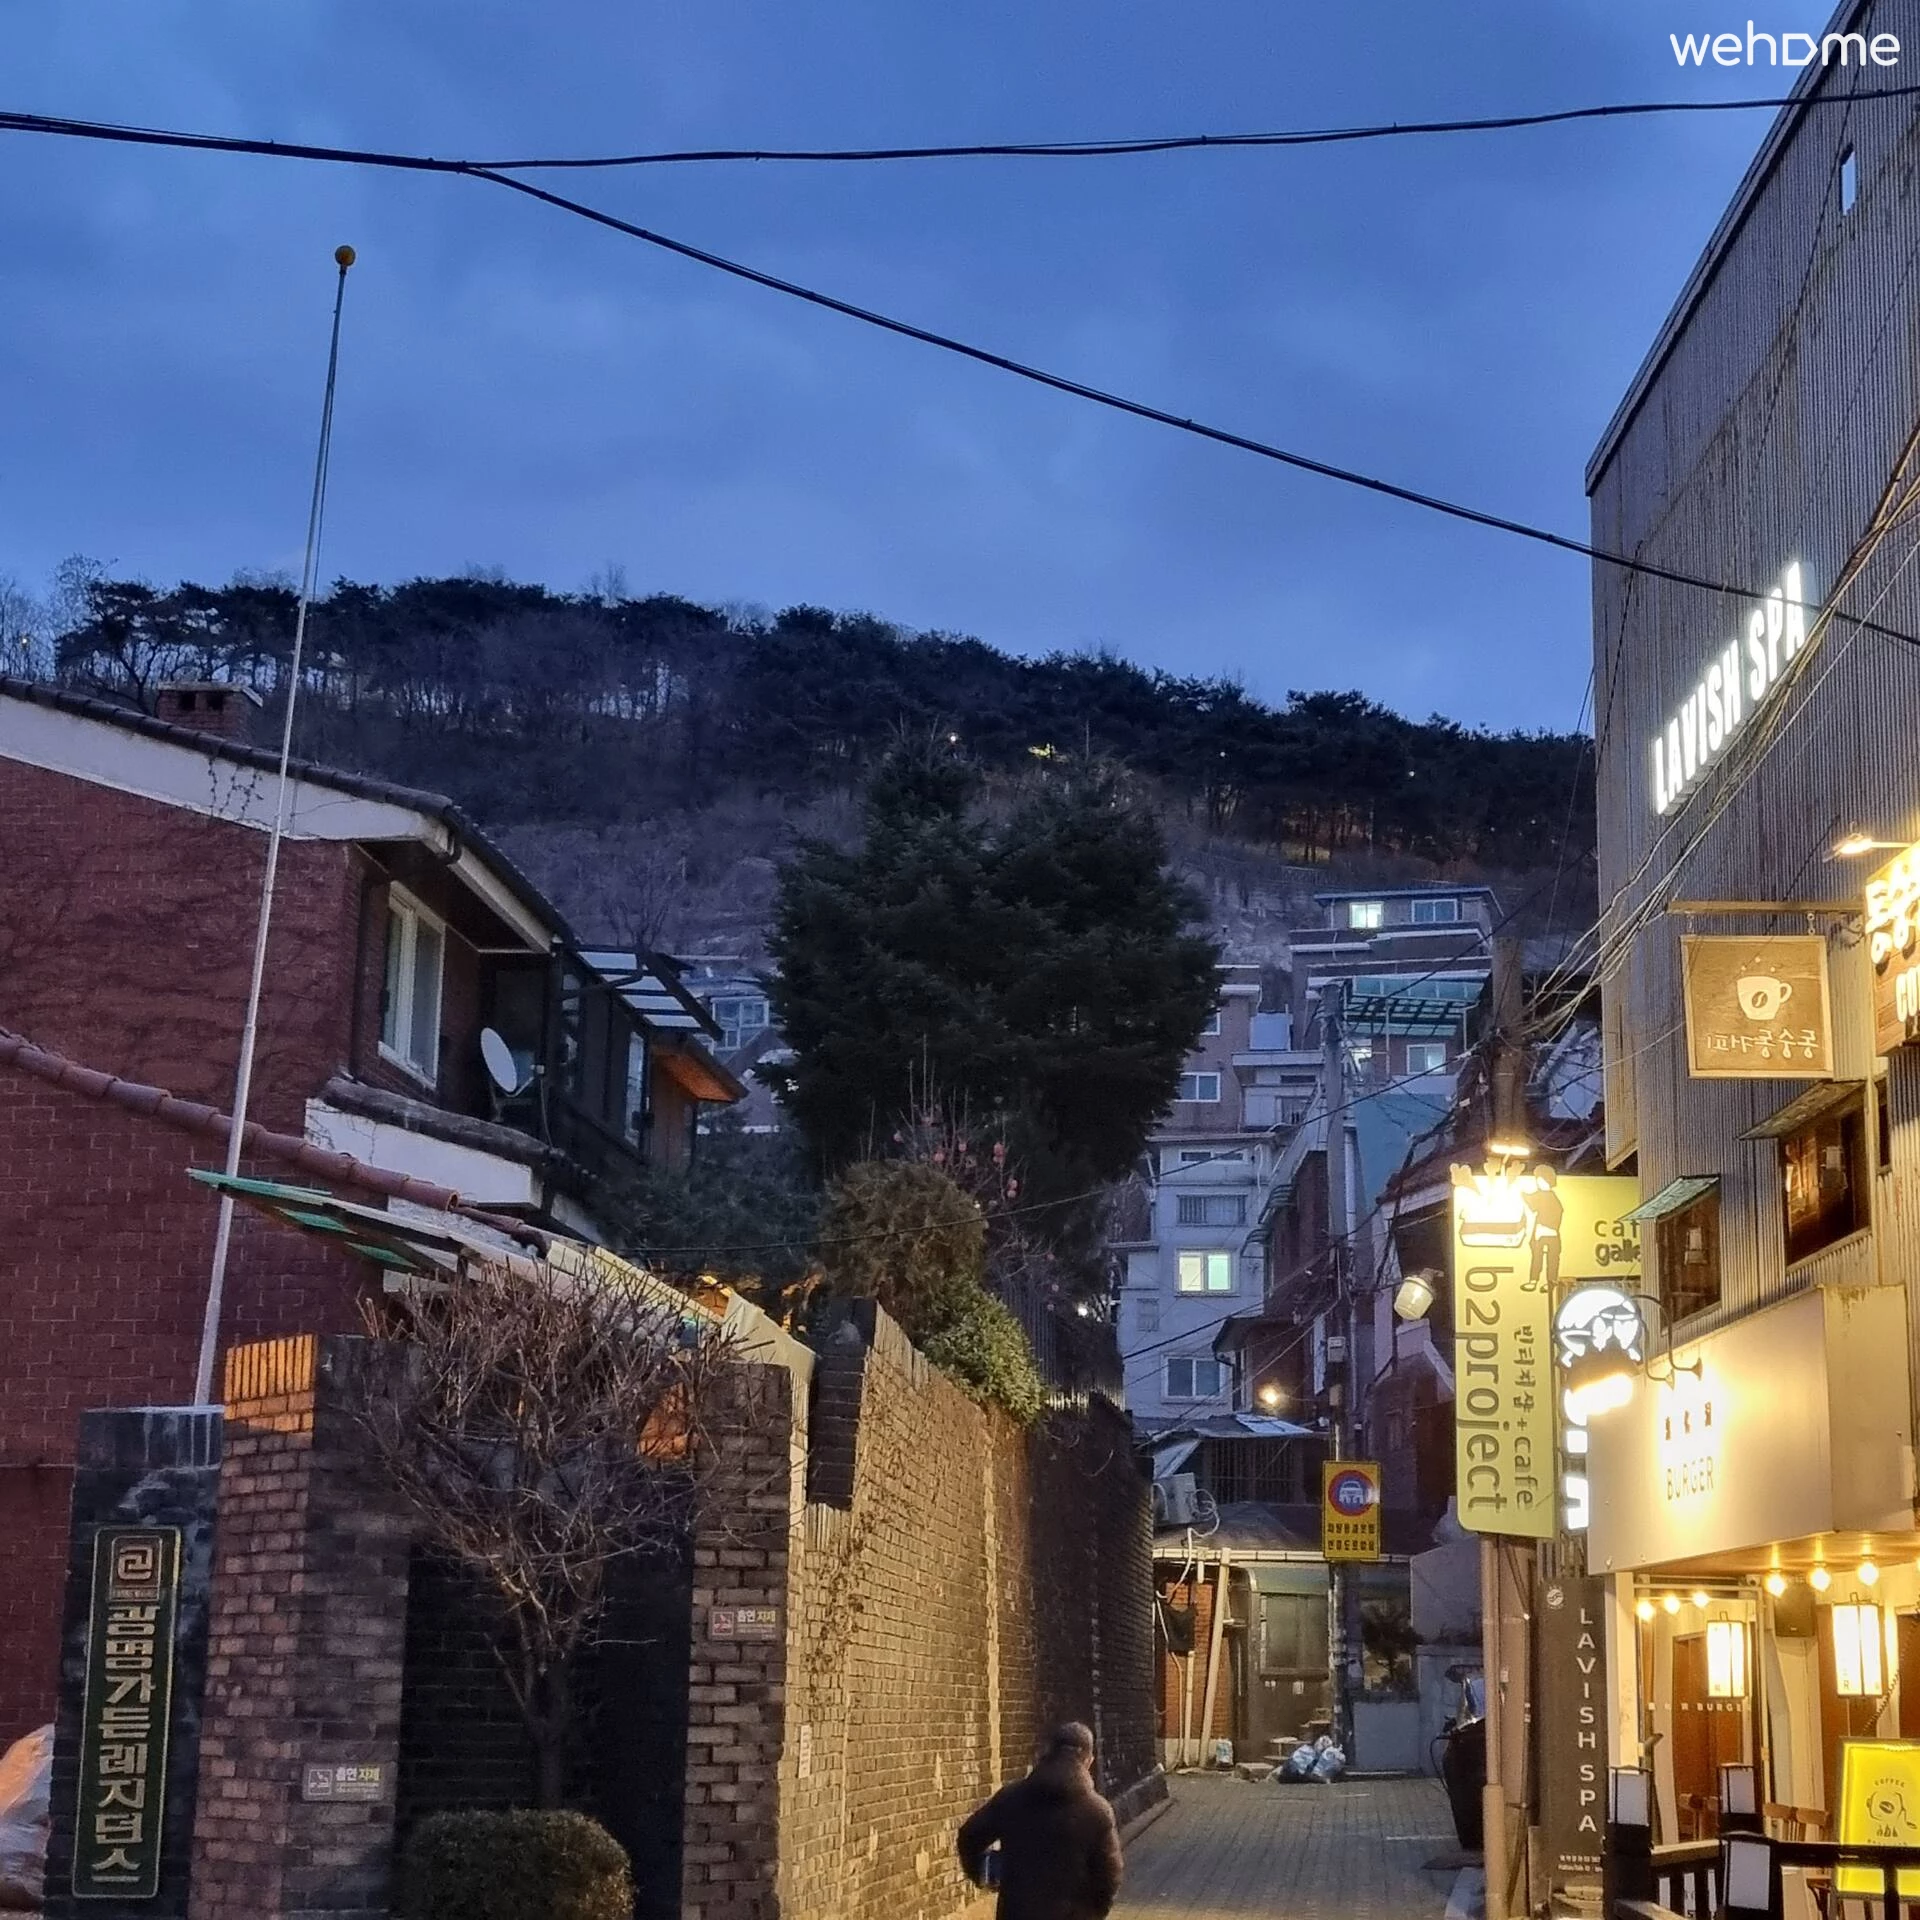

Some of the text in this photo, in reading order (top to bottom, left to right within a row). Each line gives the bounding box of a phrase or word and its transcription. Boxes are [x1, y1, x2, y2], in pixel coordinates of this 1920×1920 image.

[1653, 561, 1806, 815] LAVISH SPA
[1456, 1266, 1514, 1513] b2project
[1666, 1456, 1714, 1501] BURGER
[1577, 1607, 1597, 1750] LAVISH
[1578, 1764, 1598, 1833] SPA
